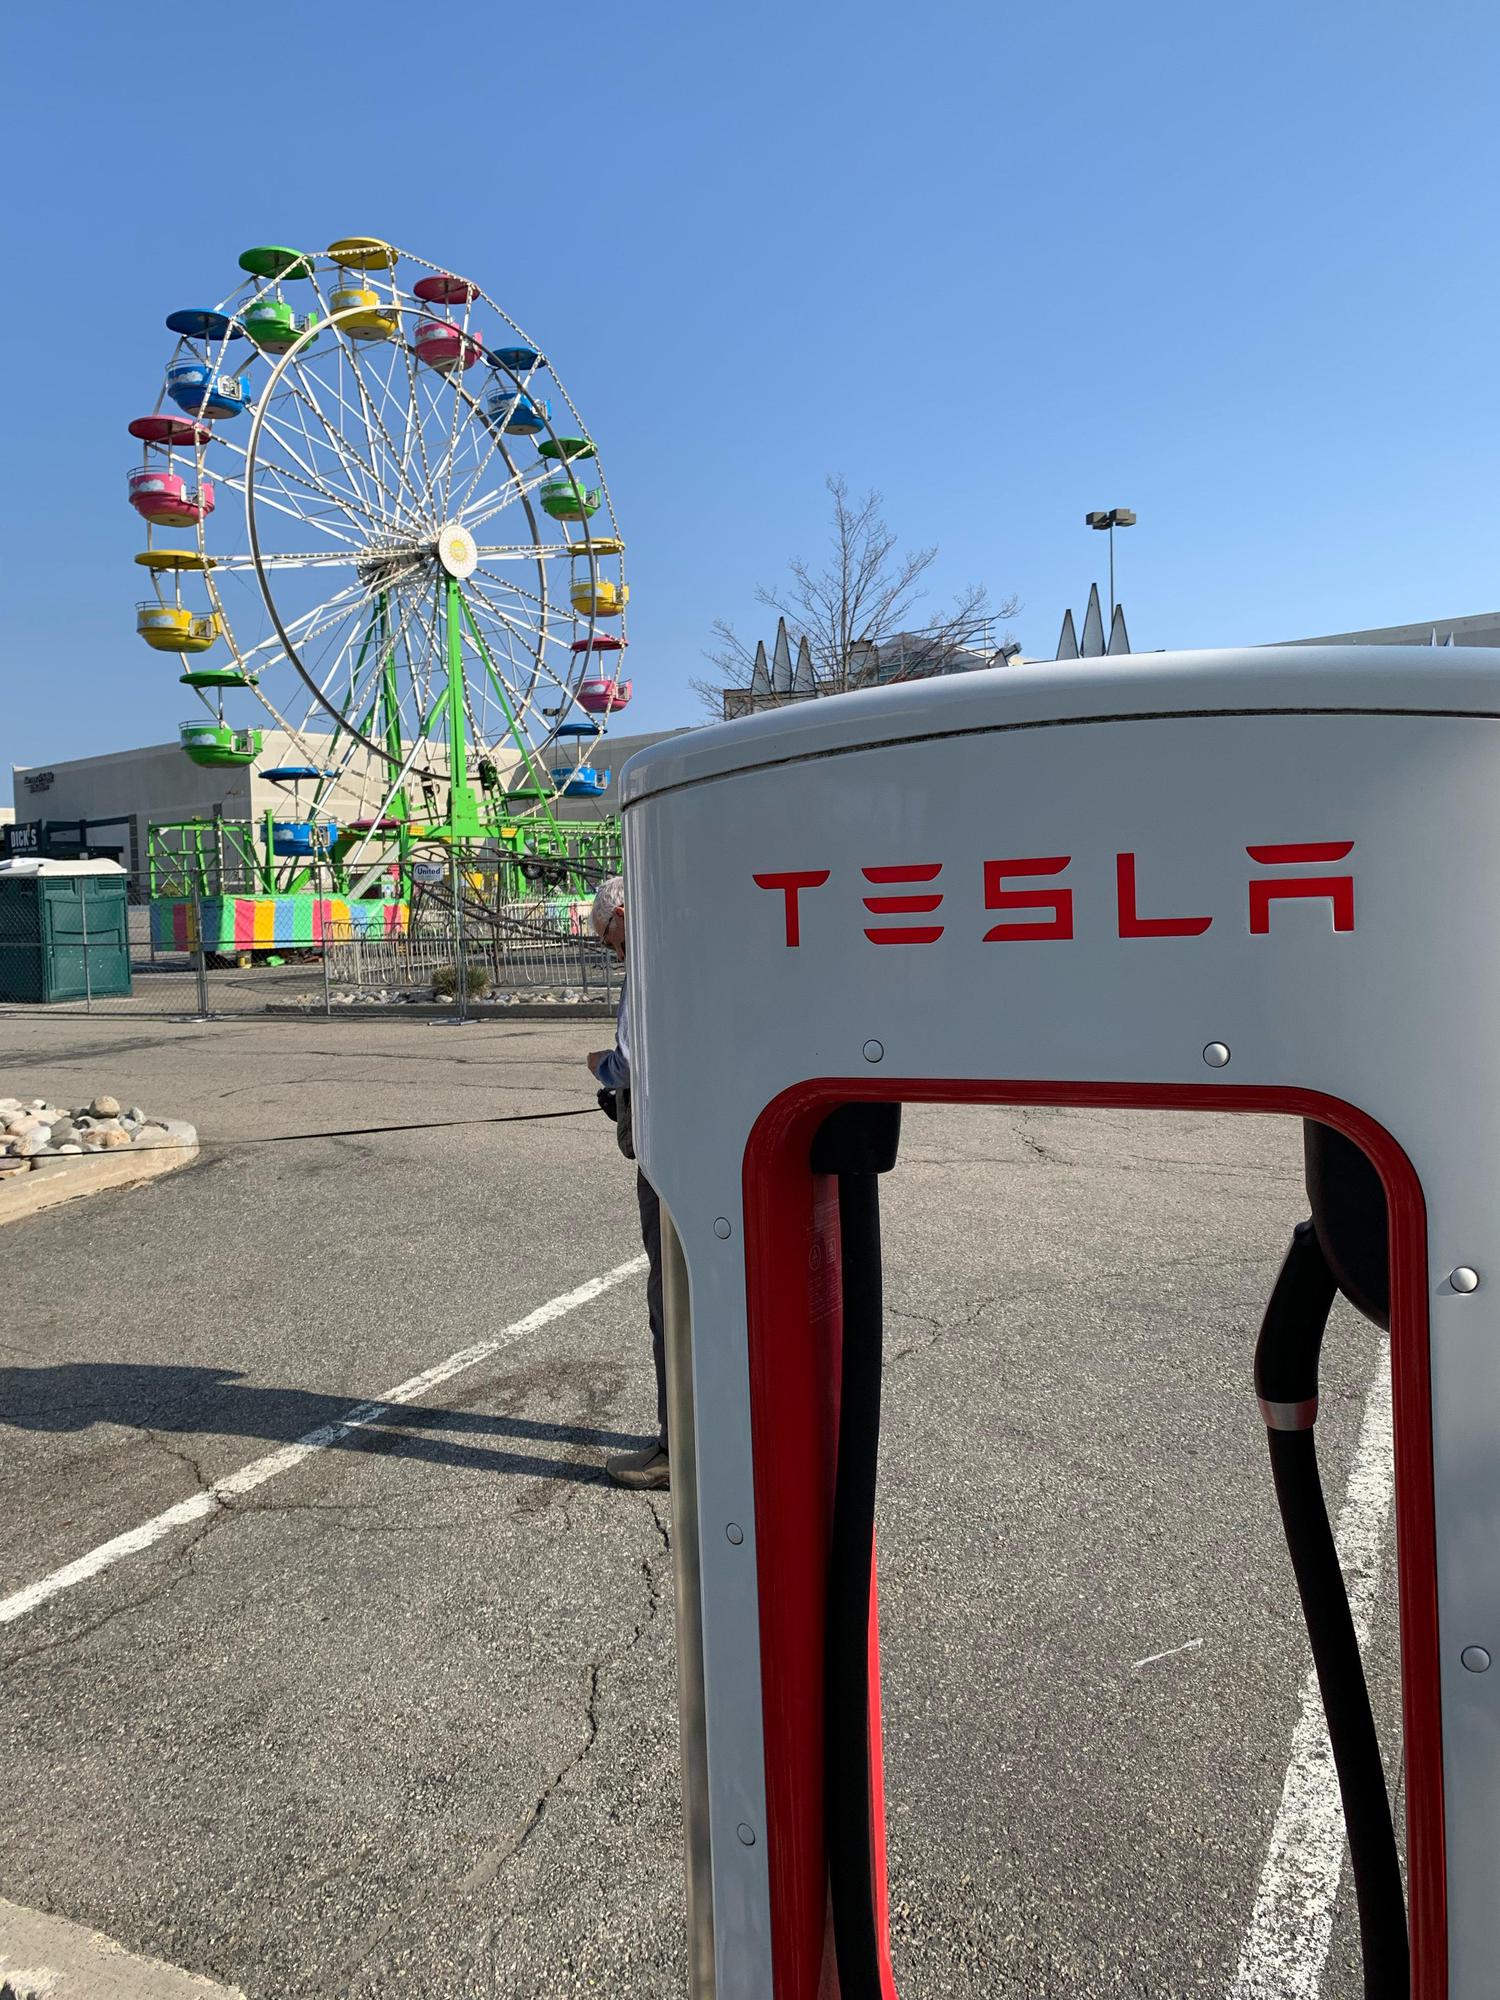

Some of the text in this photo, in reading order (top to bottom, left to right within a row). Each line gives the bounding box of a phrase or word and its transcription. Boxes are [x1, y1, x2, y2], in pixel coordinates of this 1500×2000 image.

[10, 829, 37, 848] DICK'S
[417, 867, 441, 875] United
[752, 841, 1355, 947] TESLA
